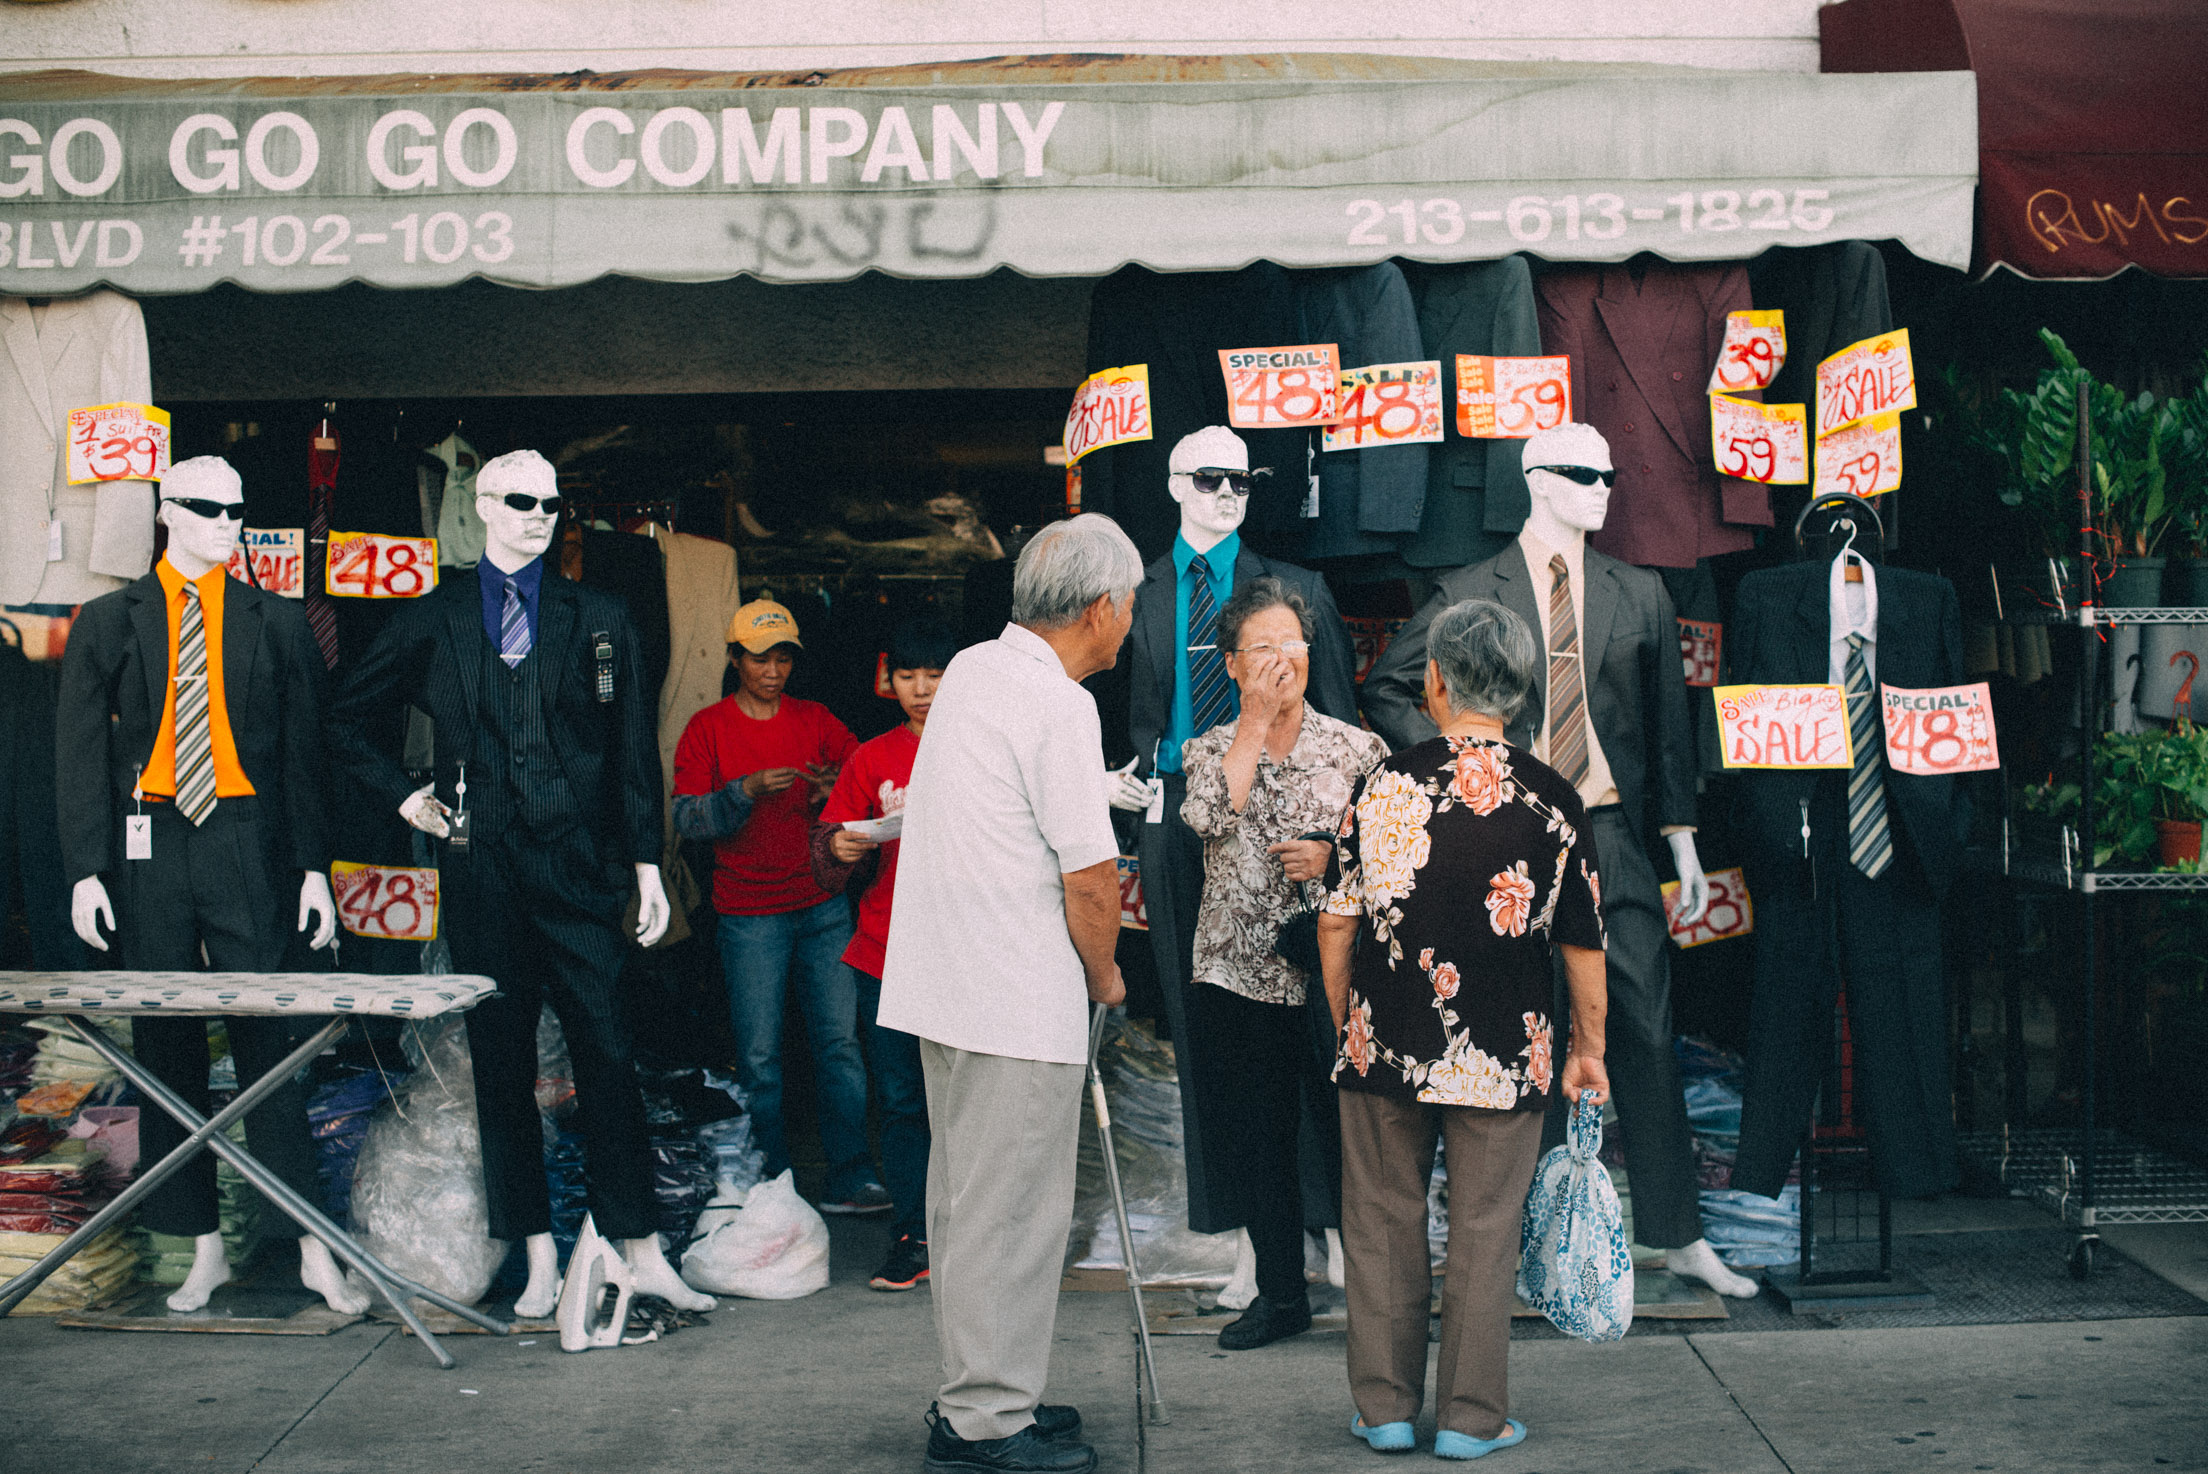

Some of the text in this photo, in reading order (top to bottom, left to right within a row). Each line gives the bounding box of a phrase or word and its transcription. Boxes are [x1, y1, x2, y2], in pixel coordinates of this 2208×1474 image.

[0, 102, 1067, 197] GO GO GO COMPANY
[0, 211, 515, 269] LVD #102-103
[1345, 188, 1835, 246] 213-613-1825
[1229, 351, 1330, 369] SPECIAL!
[1458, 389, 1495, 405] Sale
[1837, 360, 1914, 423] SALE
[1083, 395, 1148, 447] SALE
[335, 543, 424, 597] 48
[1885, 692, 1980, 710] SPECIAL!
[1733, 714, 1842, 765] SALE
[342, 874, 422, 937] 48
